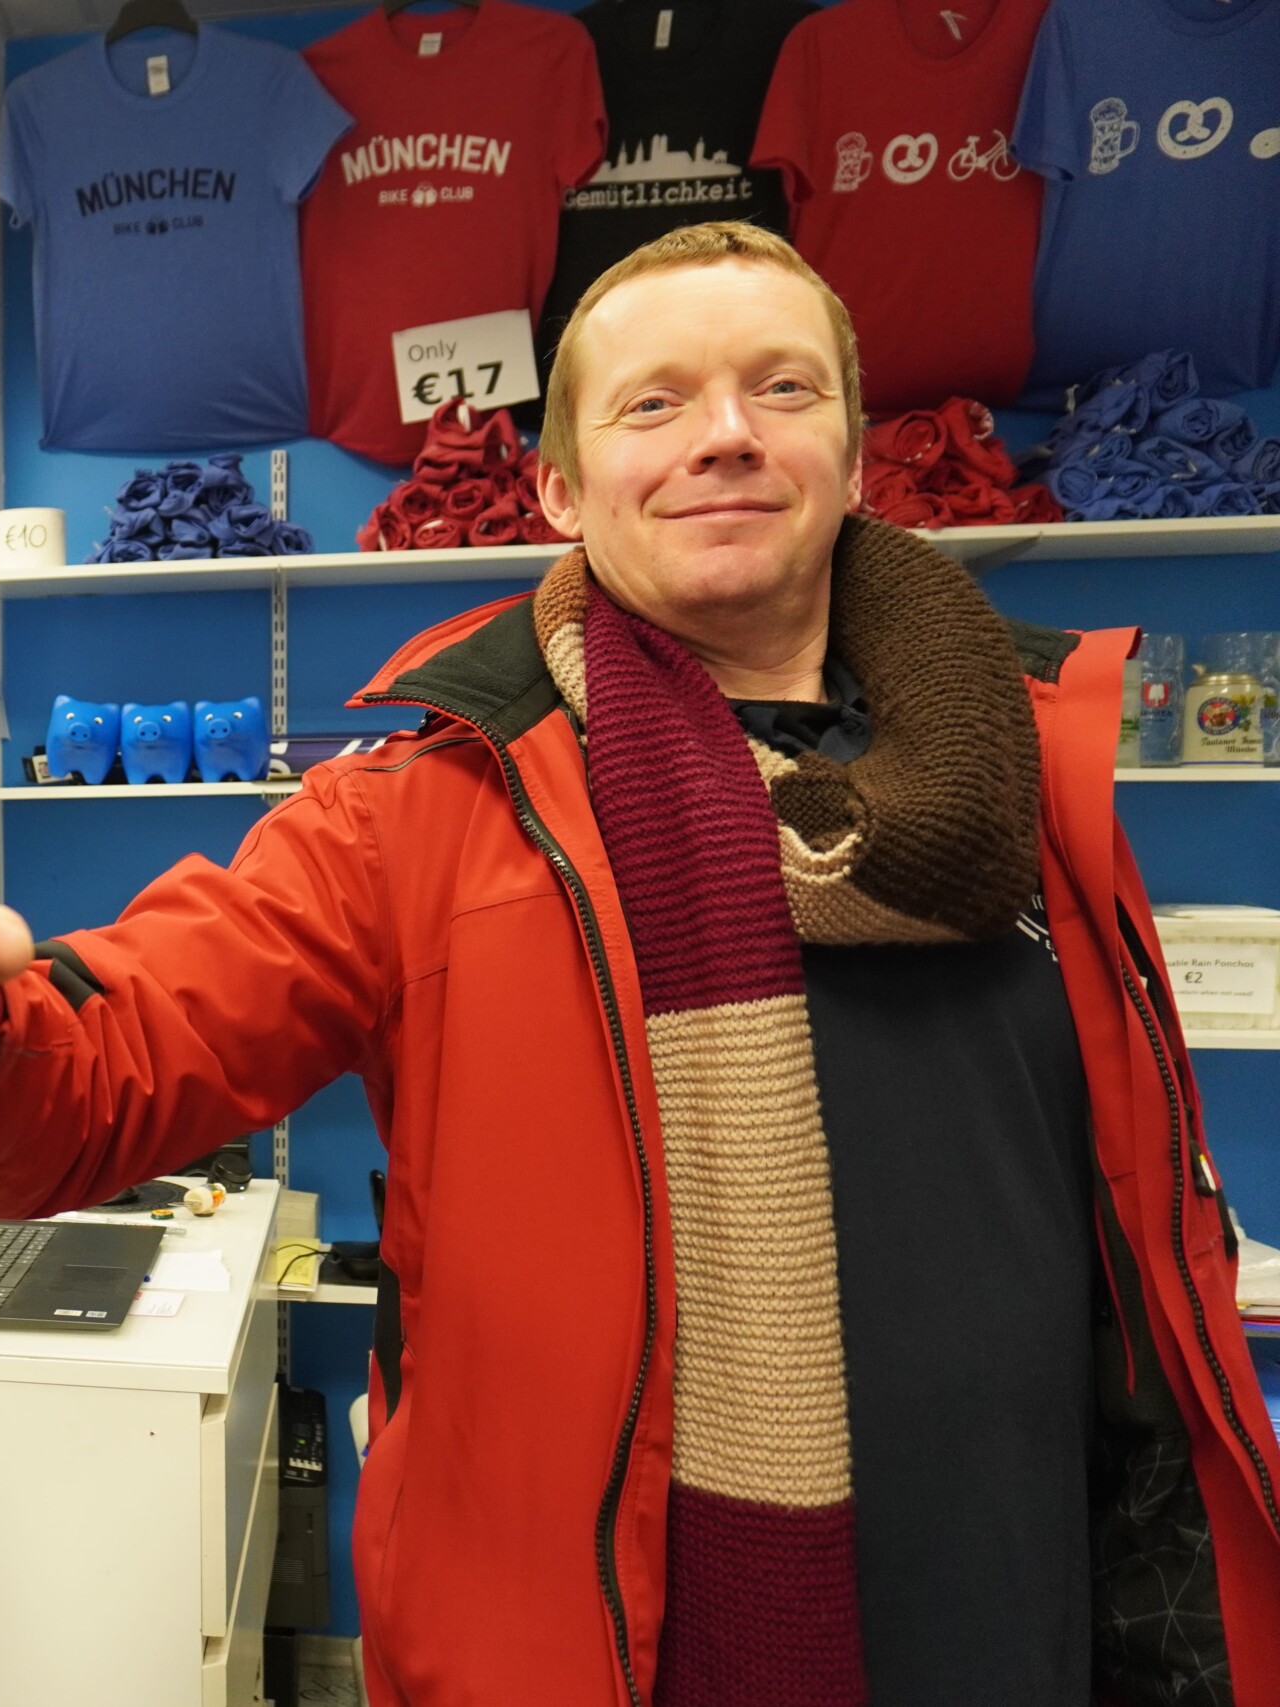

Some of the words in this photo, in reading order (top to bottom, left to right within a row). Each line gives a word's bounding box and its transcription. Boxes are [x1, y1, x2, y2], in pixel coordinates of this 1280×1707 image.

[340, 133, 512, 186] MÜNCHEN
[76, 167, 236, 217] MÜNCHEN
[378, 188, 409, 205] BIKE
[440, 186, 474, 201] CLUB
[564, 178, 752, 208] Gemütlichkeit
[113, 221, 141, 235] BIKE
[172, 215, 204, 230] CLUB
[408, 339, 457, 362] Only
[412, 360, 503, 405] €17
[5, 523, 47, 551] €10
[1191, 959, 1212, 968] Rain
[1214, 959, 1255, 968] Ponchos
[1184, 971, 1203, 984] €2
